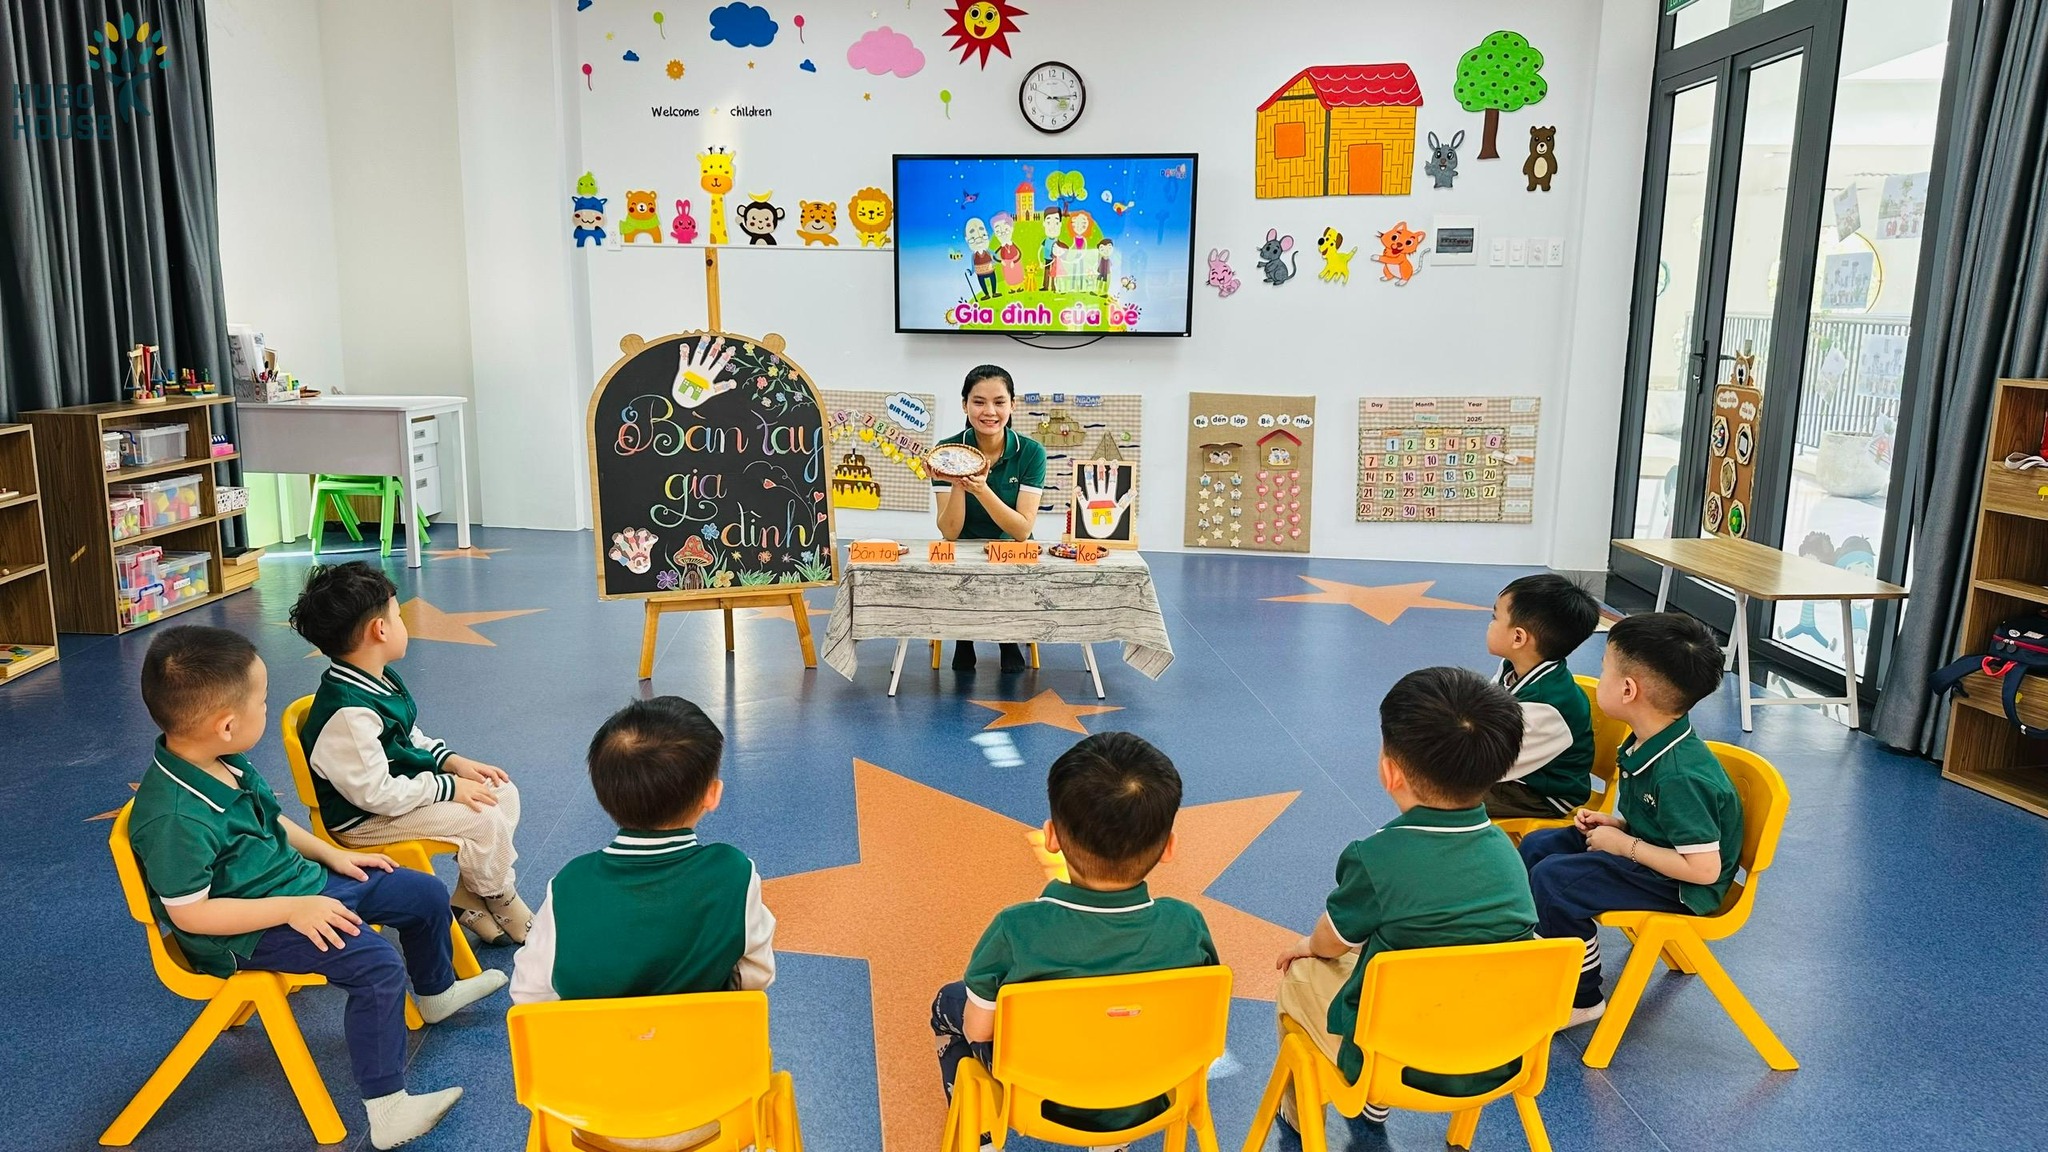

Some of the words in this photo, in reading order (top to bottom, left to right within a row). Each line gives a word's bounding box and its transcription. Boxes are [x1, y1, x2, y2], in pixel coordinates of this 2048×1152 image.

[1037, 73, 1044, 81] 11
[1048, 69, 1056, 78] 12
[1062, 72, 1065, 80] 1
[1030, 82, 1037, 91] 10
[1069, 80, 1074, 88] 2
[651, 106, 700, 117] Welcome
[730, 105, 772, 117] children
[1032, 107, 1036, 115] 8
[1062, 113, 1068, 121] 5
[954, 303, 993, 324] Gia
[1001, 302, 1051, 324] đình
[1060, 303, 1100, 325] của
[900, 397, 925, 415] HAPPY
[838, 412, 844, 421] 6
[866, 415, 872, 424] 7
[888, 403, 925, 428] BIRTHDAY
[877, 422, 884, 430] 8
[890, 428, 896, 436] 9
[751, 409, 825, 484] tay
[900, 436, 908, 446] 10
[1391, 440, 1395, 450] 1
[1407, 440, 1413, 450] 2
[1429, 439, 1435, 448] 3
[1448, 440, 1454, 448] 4
[1470, 439, 1476, 448] 5
[1490, 436, 1496, 446] 6
[912, 442, 920, 452] 11
[1369, 456, 1374, 466] 7
[1388, 456, 1394, 465] 8
[1406, 455, 1412, 464] 9
[1428, 456, 1436, 466] 10
[1448, 456, 1456, 464] 11
[1466, 454, 1474, 464] 12
[1366, 472, 1374, 482] 14
[1386, 472, 1394, 482] 15
[1404, 472, 1414, 482] 16
[1426, 472, 1434, 482] 17
[1446, 472, 1454, 480] 18
[1464, 471, 1474, 480] 19
[1484, 470, 1495, 480] 20
[1364, 488, 1372, 498] 21
[1384, 489, 1394, 498] 22
[1403, 488, 1414, 498] 23
[1424, 486, 1434, 496] 24
[1444, 488, 1456, 498] 25
[1464, 488, 1476, 498] 26
[1484, 486, 1496, 497] 27
[650, 468, 728, 528] gia
[1360, 504, 1371, 514] 28
[1382, 507, 1394, 516] 29
[1404, 506, 1415, 516] 30
[1426, 507, 1436, 516] 31
[880, 547, 898, 562] tay
[989, 544, 1016, 562] Ngôi
